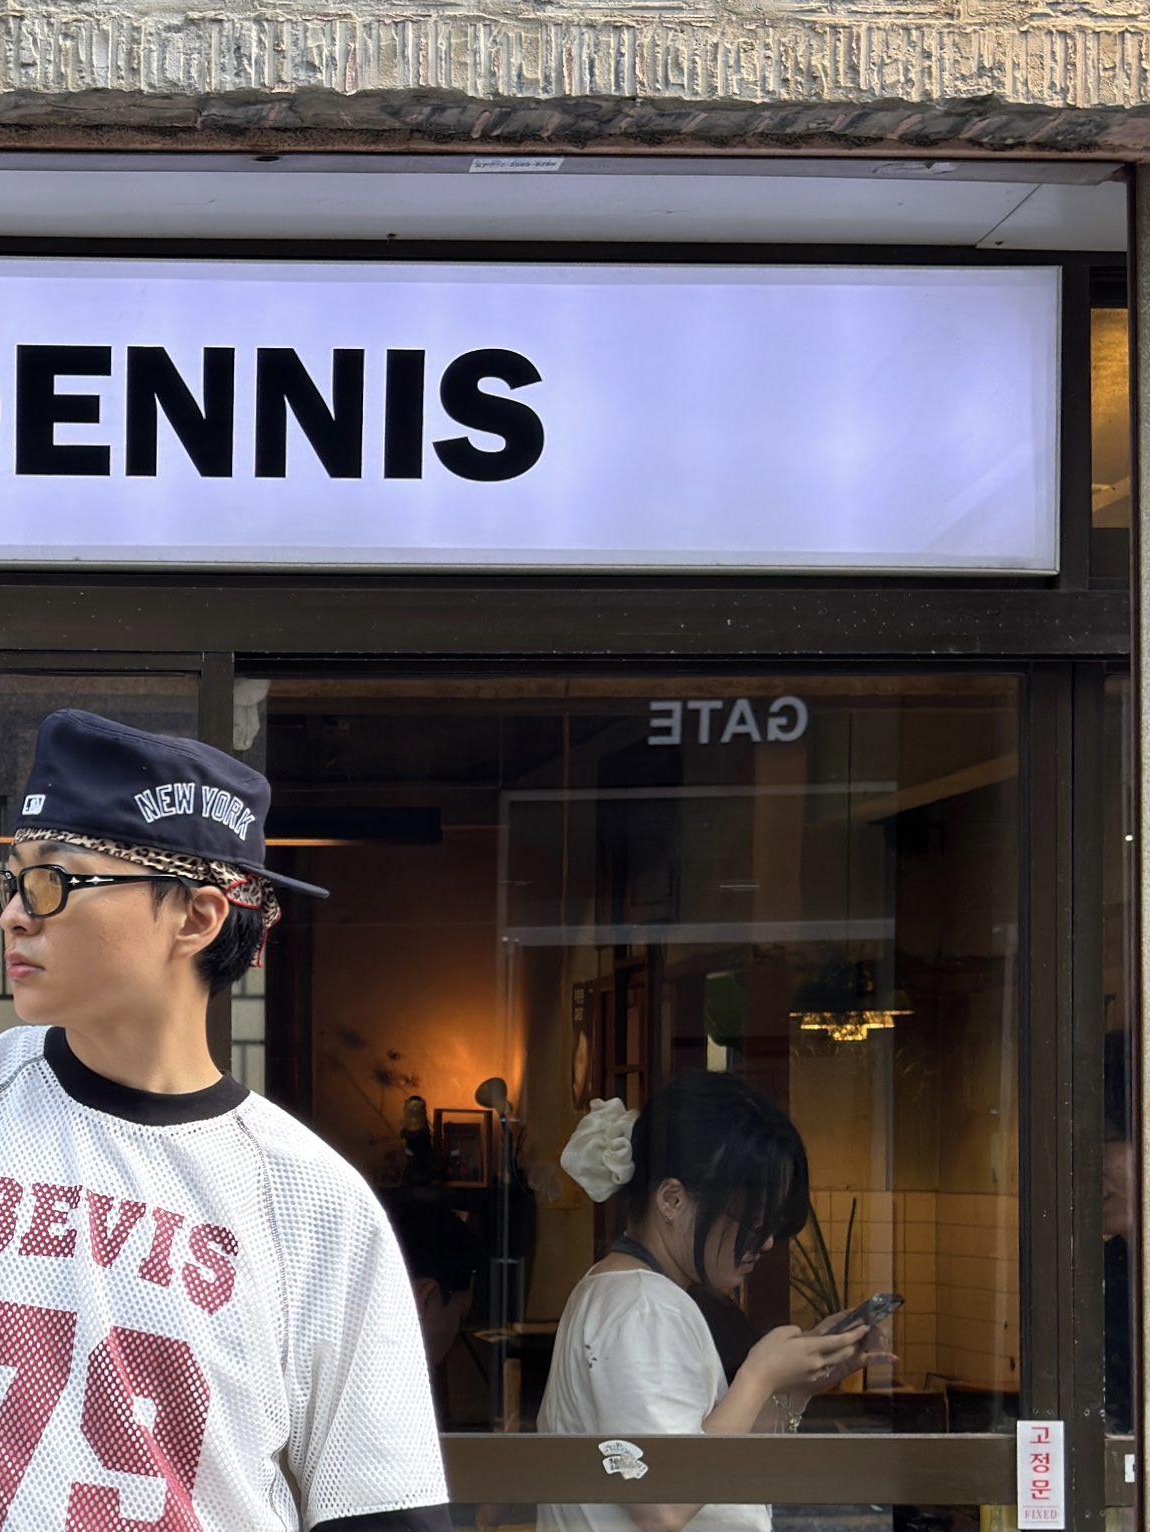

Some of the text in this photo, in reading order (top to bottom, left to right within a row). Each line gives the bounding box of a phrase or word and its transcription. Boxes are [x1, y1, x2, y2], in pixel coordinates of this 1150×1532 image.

[133, 782, 256, 841] NEW YORK
[1029, 1426, 1052, 1500] 고정문
[1024, 1509, 1058, 1520] FIXED
